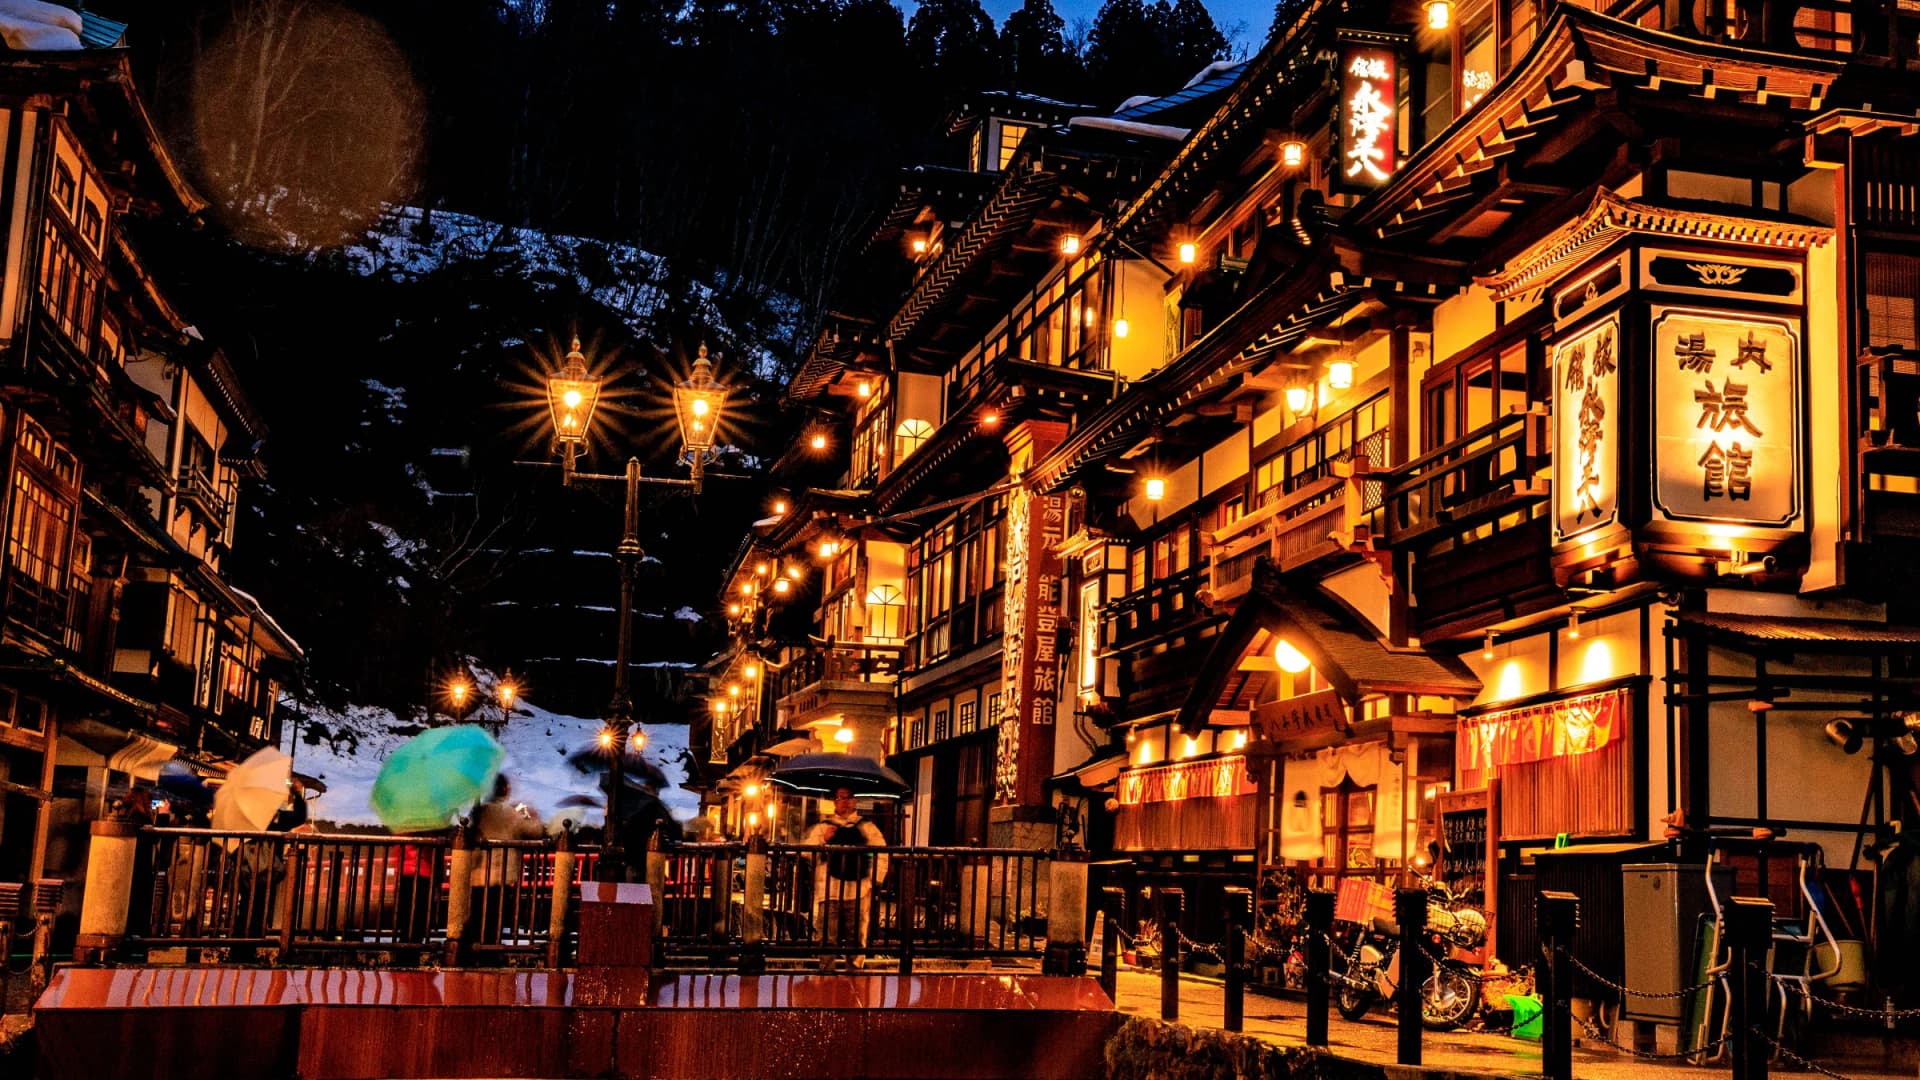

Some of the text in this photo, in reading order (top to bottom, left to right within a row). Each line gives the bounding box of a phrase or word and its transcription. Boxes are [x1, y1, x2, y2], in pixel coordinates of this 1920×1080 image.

[1693, 376, 1764, 502] 旅館
[1031, 495, 1062, 726] 湯元 能登屋旅館
